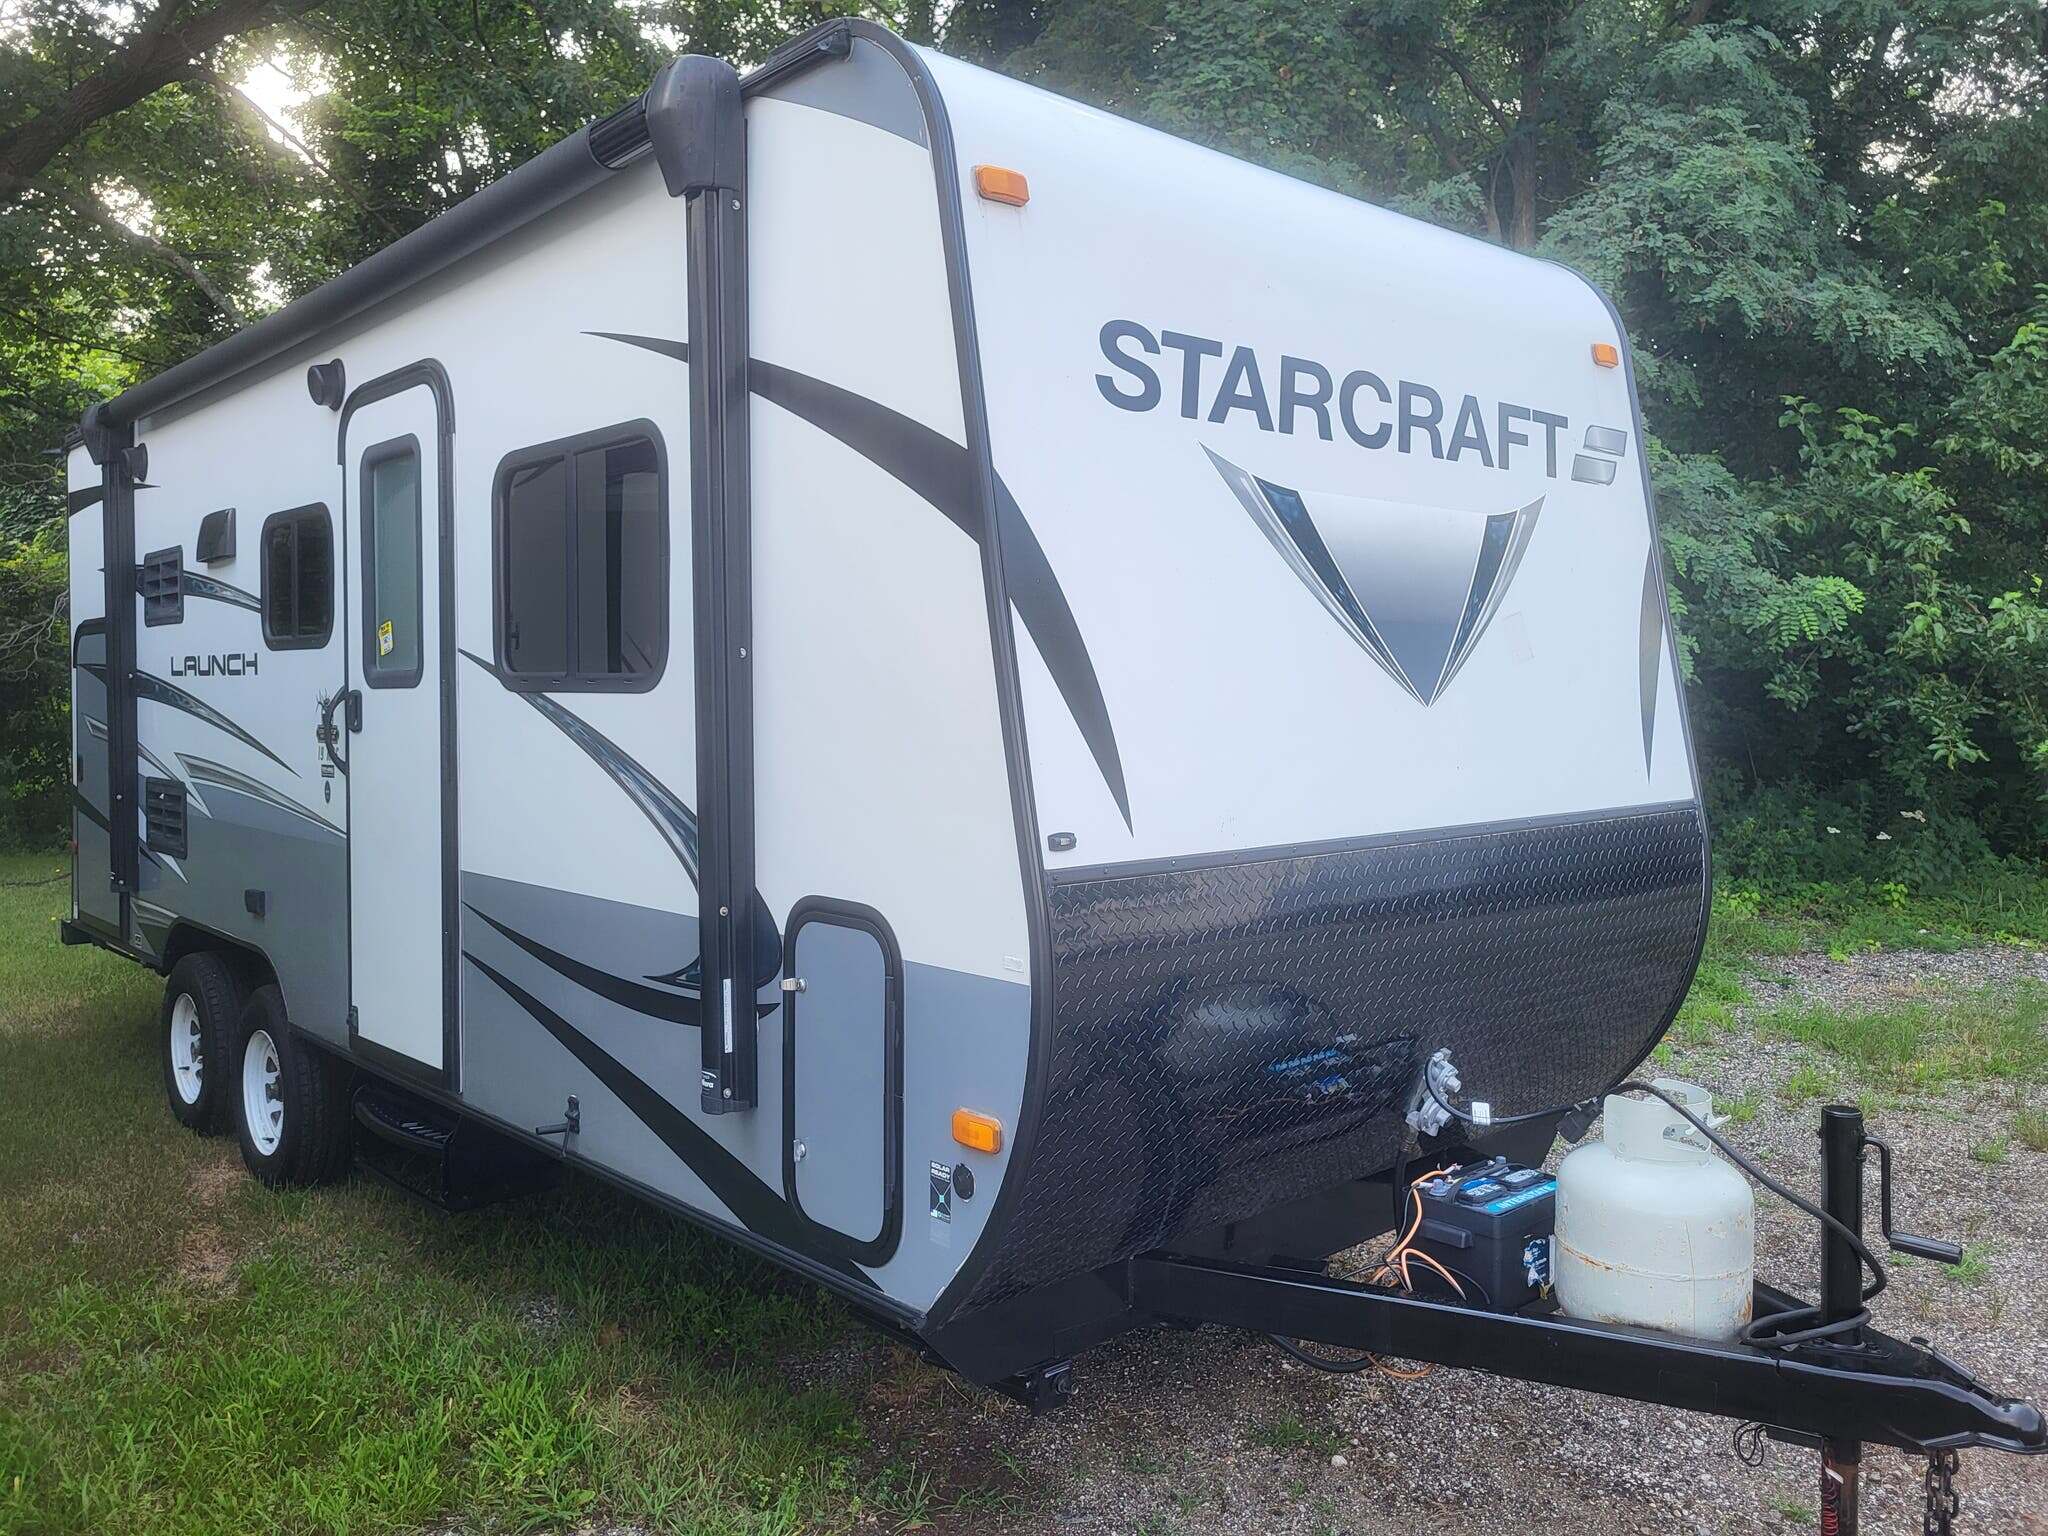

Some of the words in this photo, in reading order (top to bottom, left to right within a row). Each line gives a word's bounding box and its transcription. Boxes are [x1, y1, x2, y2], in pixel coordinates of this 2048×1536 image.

[1095, 319, 1569, 478] STARCRAFT
[170, 652, 258, 677] LAUNCH
[931, 1162, 950, 1173] SOLAR
[931, 1168, 950, 1180] READY
